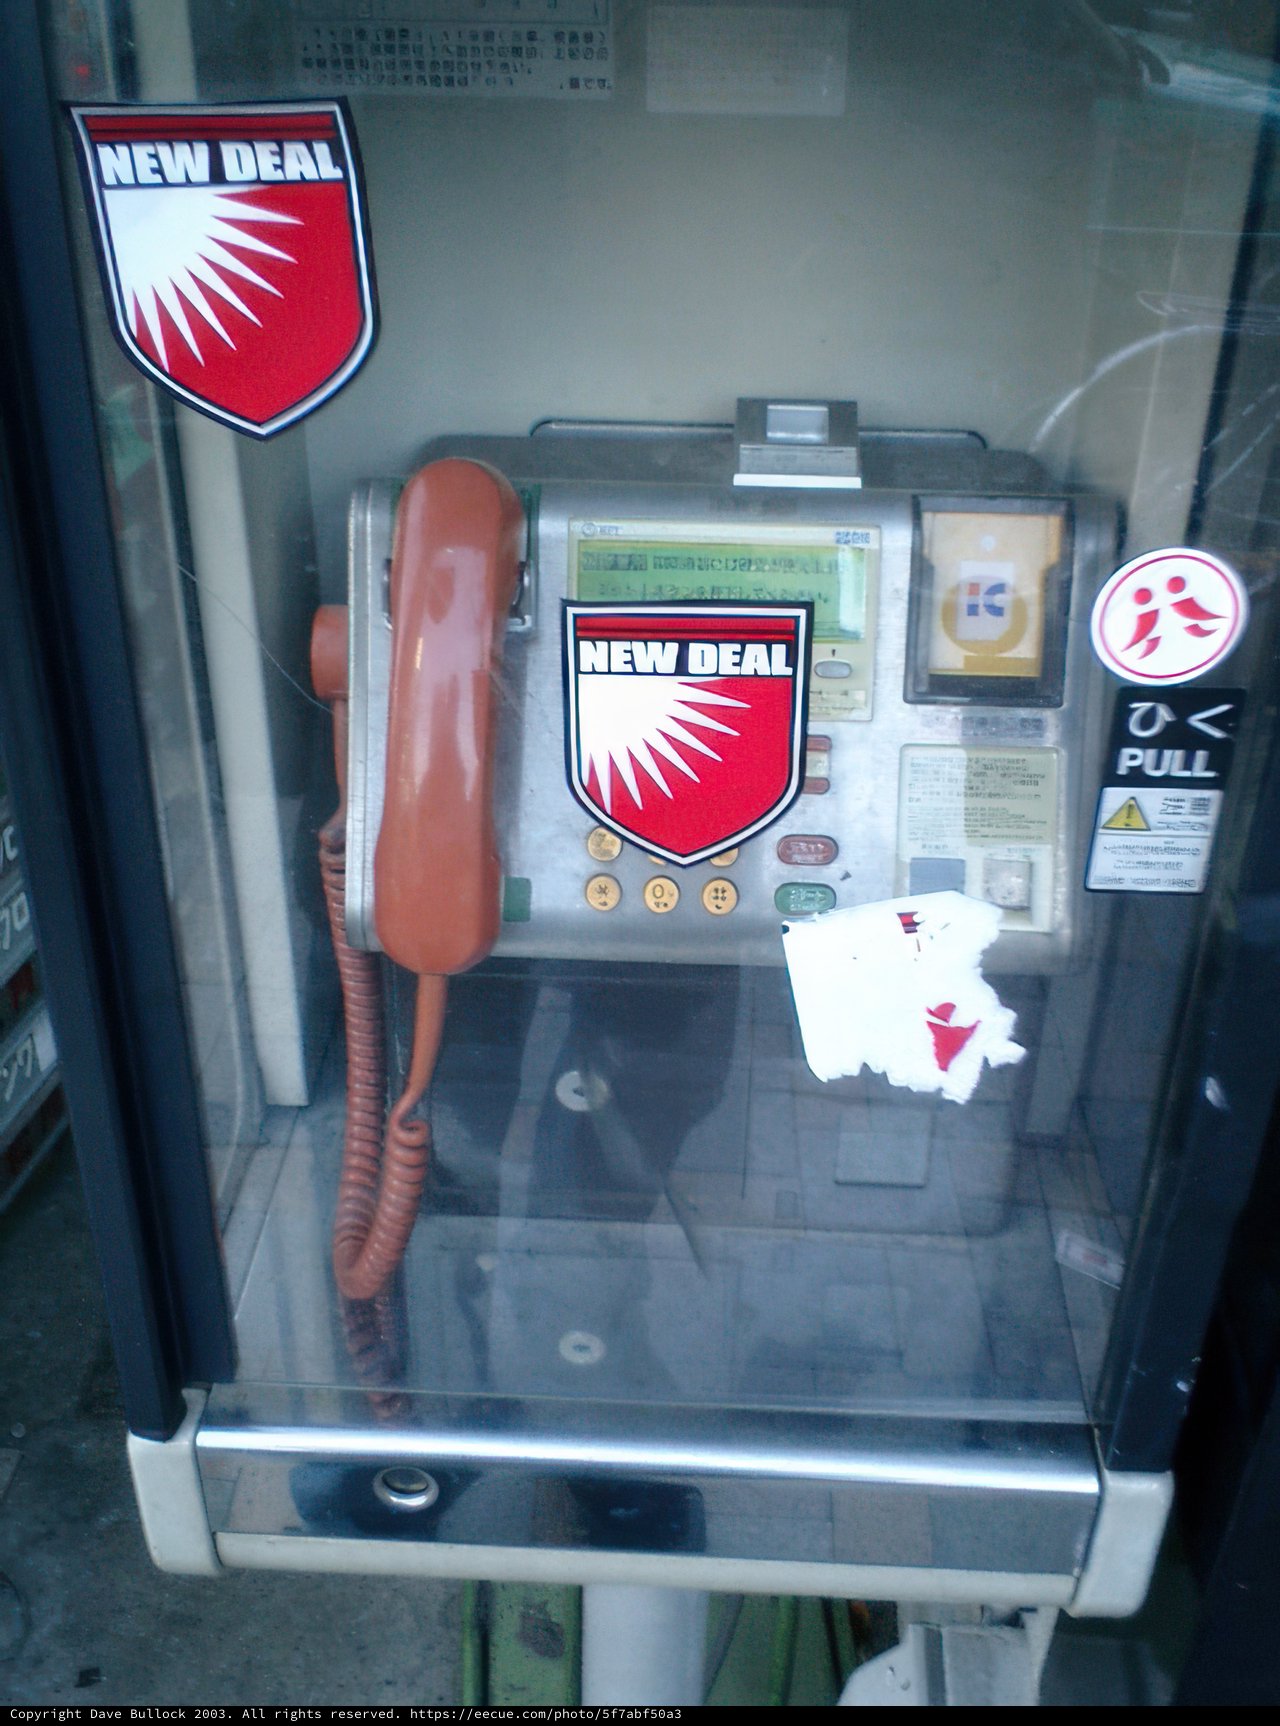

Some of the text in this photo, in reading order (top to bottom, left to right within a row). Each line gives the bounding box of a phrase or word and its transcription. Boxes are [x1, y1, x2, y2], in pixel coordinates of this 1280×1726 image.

[96, 139, 343, 185] NEW DEAL
[579, 640, 793, 676] NEW DEAL
[1128, 701, 1235, 738] ひく
[1116, 747, 1219, 778] PULL
